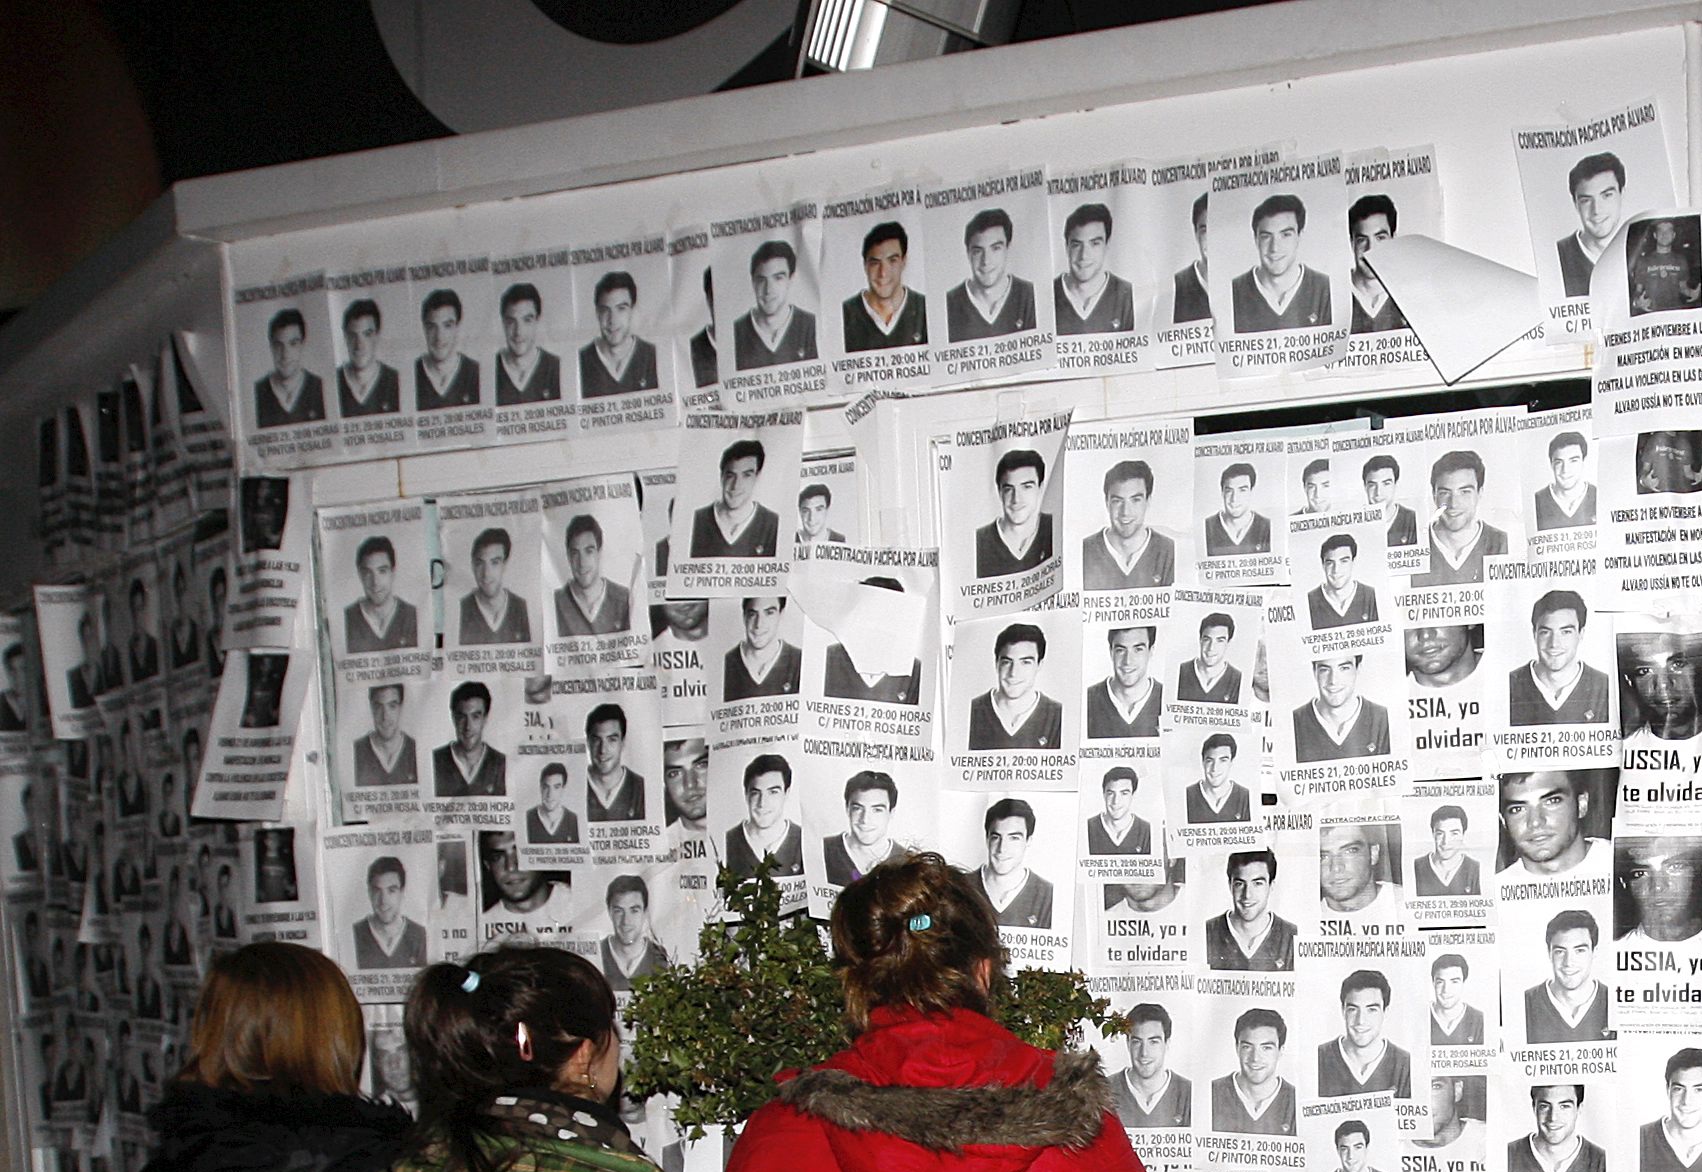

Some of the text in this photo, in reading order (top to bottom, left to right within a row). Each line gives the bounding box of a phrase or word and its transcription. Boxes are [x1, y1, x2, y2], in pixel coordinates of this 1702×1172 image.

[934, 333, 1052, 362] VIERNES 21, 20:00 HORAS
[1219, 329, 1347, 353] VIERNES 21, 20:00 HORAS
[948, 349, 1042, 374] C/ PINTOR ROSALES
[1233, 345, 1334, 367] C/ PINTOR ROSALES
[674, 563, 789, 574] VIERNES 21, 20:00 HORAS
[684, 576, 777, 587] C/ PINTOR ROSALES
[951, 755, 1076, 767] VIERNES 21, 20:00 HORAS
[1623, 749, 1686, 772] USSIA,
[963, 770, 1063, 781] C/ PINTOR ROSALES
[1623, 786, 1640, 802] te
[1107, 920, 1177, 939] USSIA, yo
[1108, 945, 1187, 961] te olvidare
[1616, 951, 1681, 973] USSIA,
[1616, 987, 1635, 1003] te
